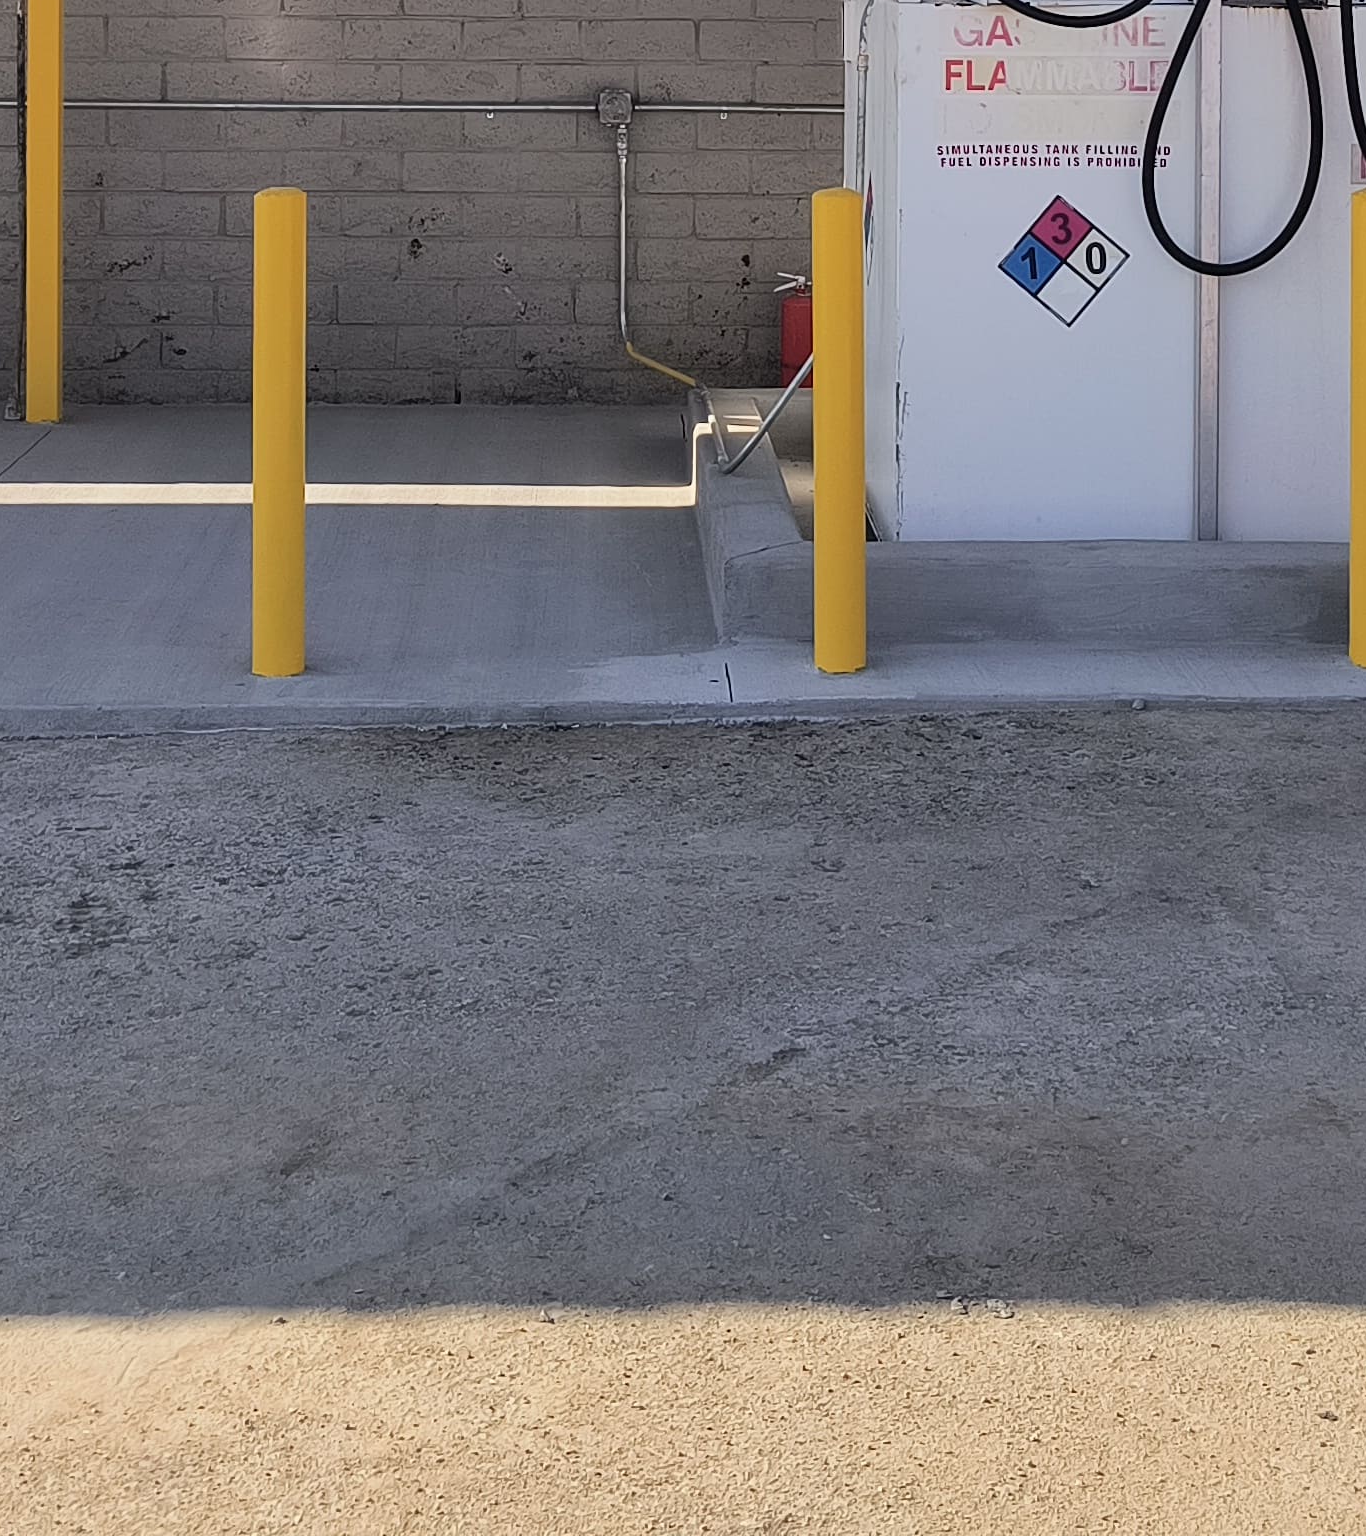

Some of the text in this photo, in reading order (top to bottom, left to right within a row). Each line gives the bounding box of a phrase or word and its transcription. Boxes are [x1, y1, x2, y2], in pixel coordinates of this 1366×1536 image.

[954, 15, 1166, 46] GAINE
[937, 144, 1171, 156] SIMULTANEOUS TANK FILLING ND
[941, 156, 1167, 168] FUEL DISPENSING IS PROHIBIED
[1051, 213, 1072, 244] 3
[1021, 242, 1107, 280] 1 0
